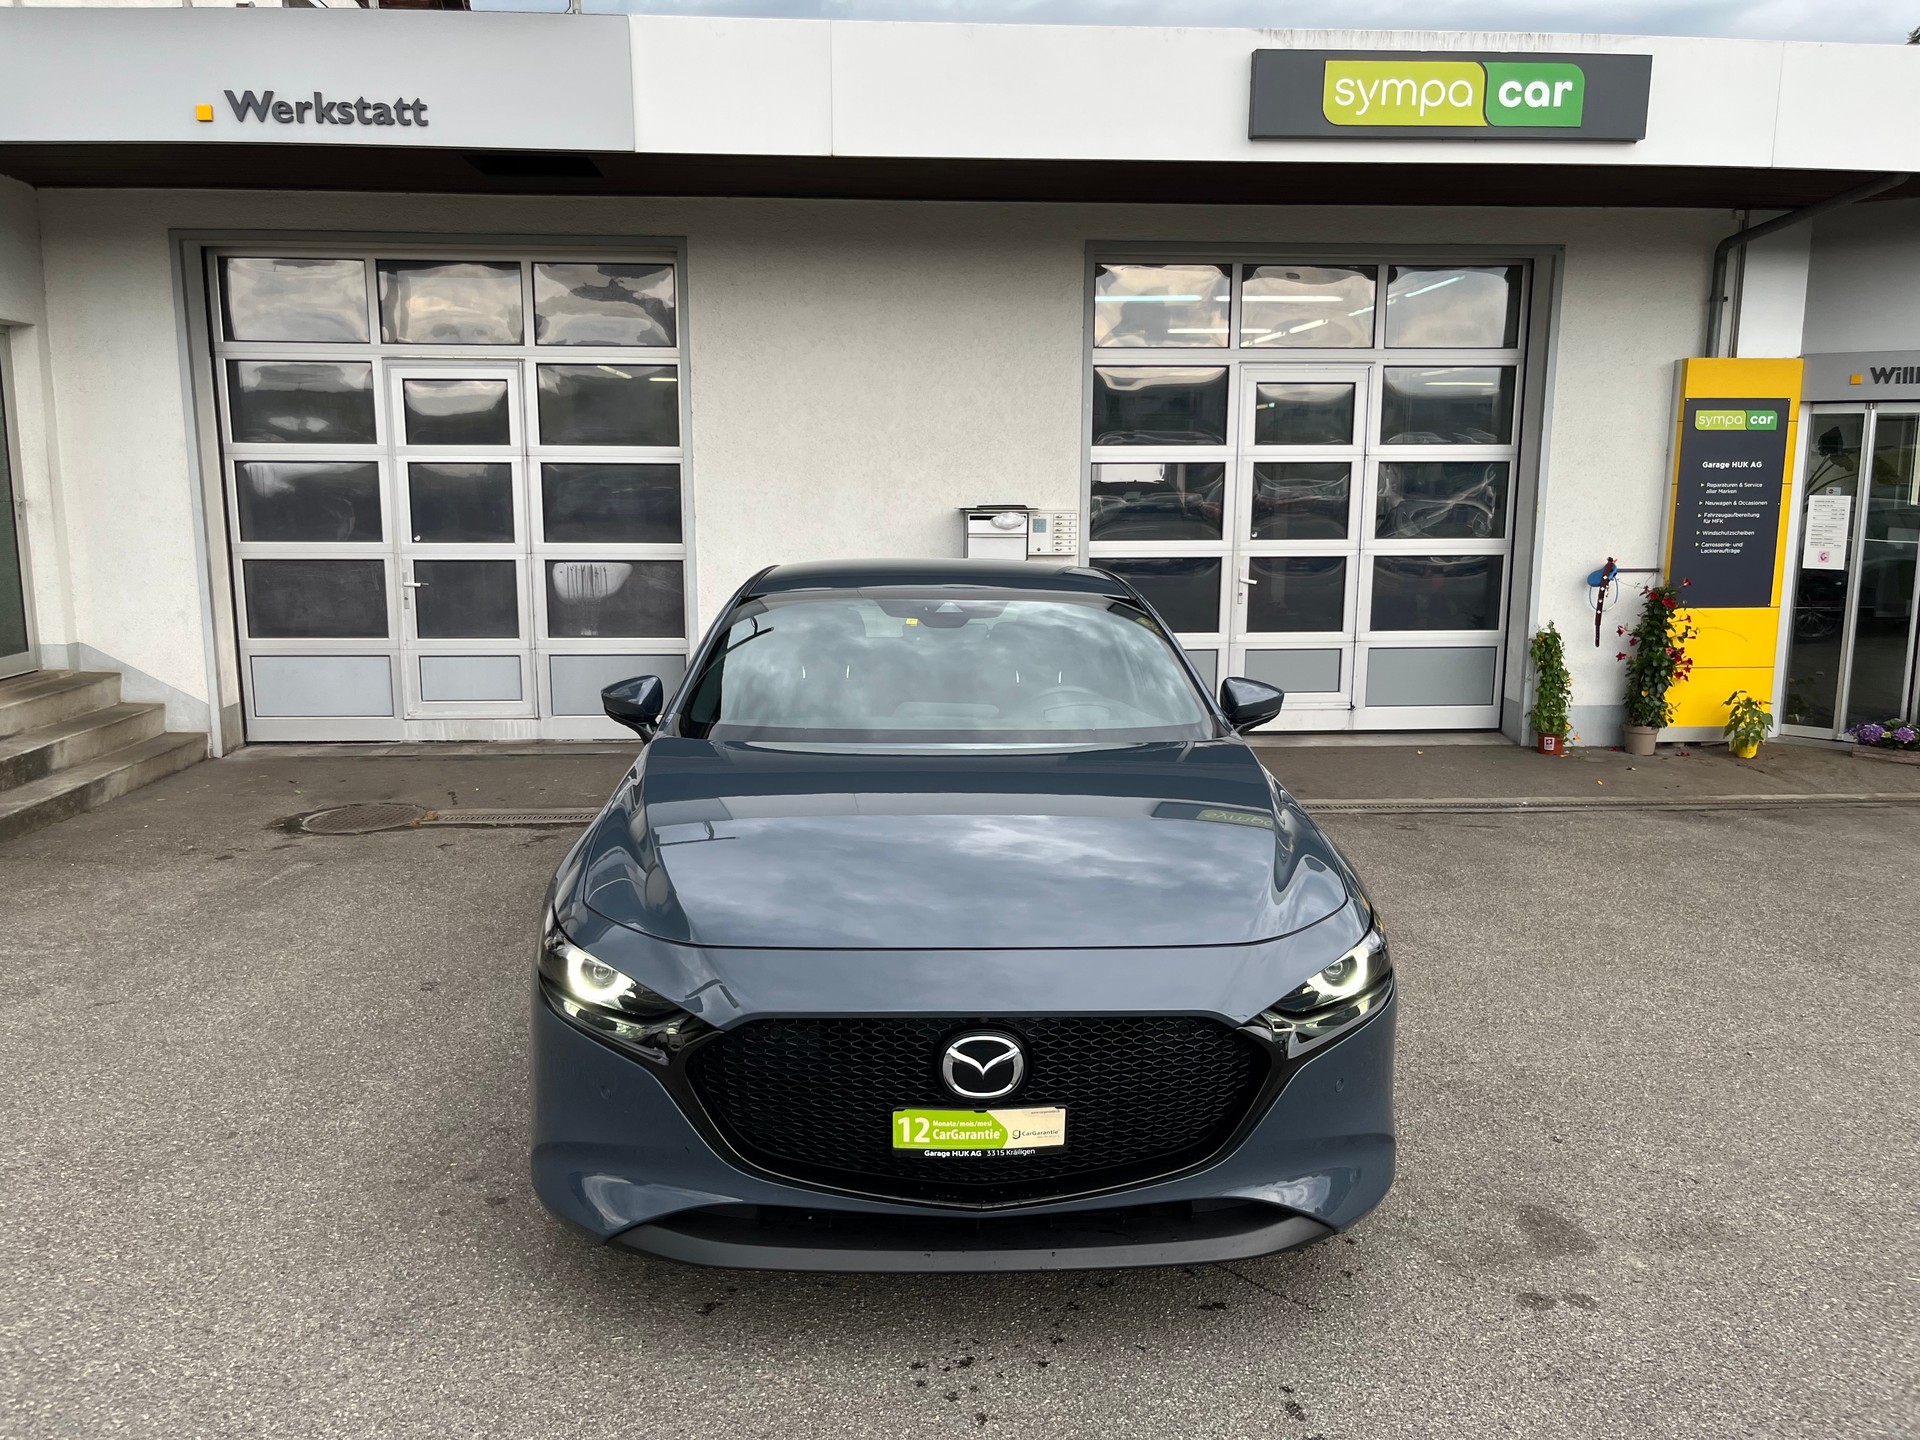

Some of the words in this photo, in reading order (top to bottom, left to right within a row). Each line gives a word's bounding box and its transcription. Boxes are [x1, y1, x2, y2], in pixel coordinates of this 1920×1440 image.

[1334, 77, 1472, 116] sympa
[1498, 80, 1573, 108] car
[223, 89, 429, 127] Werkstatt
[1698, 415, 1743, 427] sympa
[1750, 415, 1774, 424] car
[1702, 461, 1730, 469] Garage
[897, 1116, 931, 1143] 12
[924, 1149, 951, 1158] Garage
